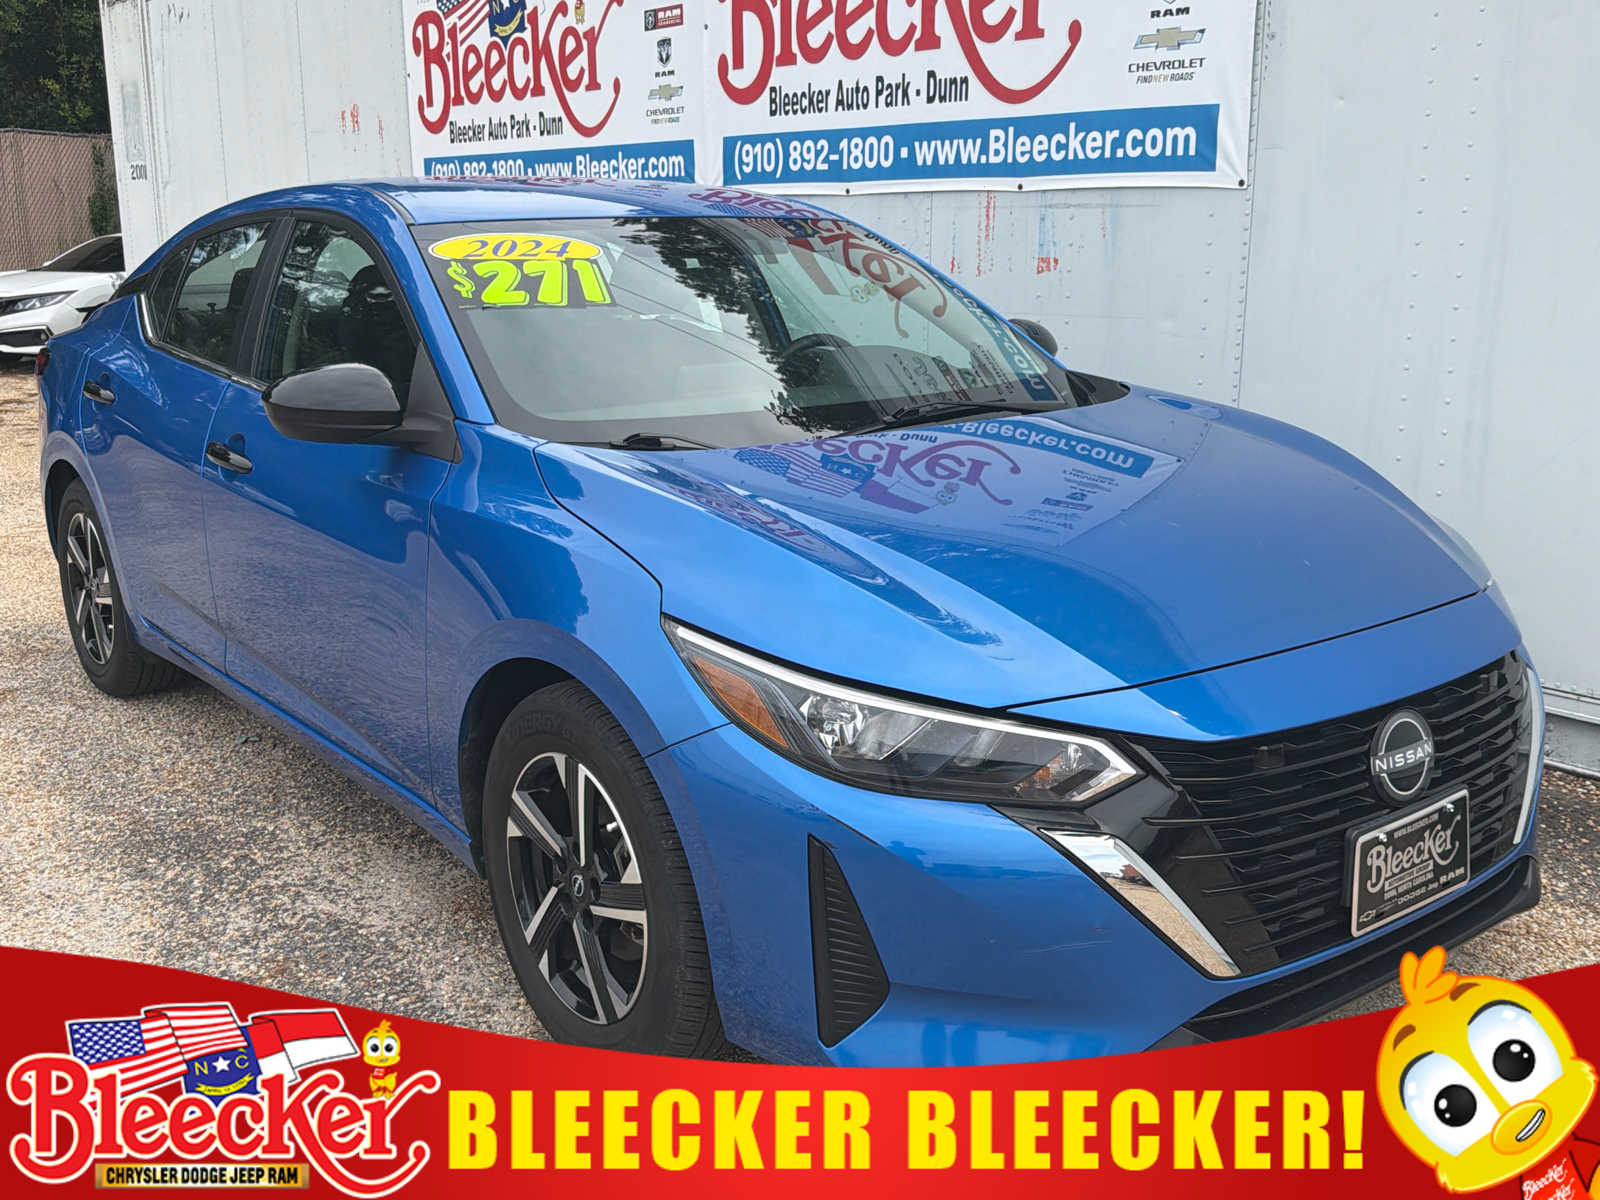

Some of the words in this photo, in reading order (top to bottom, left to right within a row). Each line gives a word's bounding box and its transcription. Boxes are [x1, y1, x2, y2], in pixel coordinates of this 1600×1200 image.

[658, 8, 681, 18] RAM
[1150, 6, 1190, 18] RAM
[412, 0, 625, 137] Bleecker
[655, 70, 675, 78] RAM
[1128, 57, 1206, 73] CHEVROLET
[769, 83, 831, 117] Bleecker
[835, 80, 869, 112] Auto
[875, 73, 910, 108] Park
[927, 70, 969, 105] Dunn
[646, 106, 685, 117] CHEVROLET
[449, 119, 486, 144] Bleecker
[488, 116, 508, 139] Auto
[510, 113, 532, 137] Park
[539, 112, 564, 137] Dunn
[733, 137, 784, 180] (910)
[789, 135, 894, 172] 892-1800
[915, 121, 1196, 166] www.Bleecker.com
[464, 158, 524, 178] 892-1800
[535, 152, 685, 179] www.Bleecker.com
[463, 238, 574, 258] 2024
[447, 258, 612, 306] $271
[1375, 743, 1433, 773] NISSAN
[1366, 814, 1462, 894] Bleecker
[1440, 866, 1465, 884] RAM
